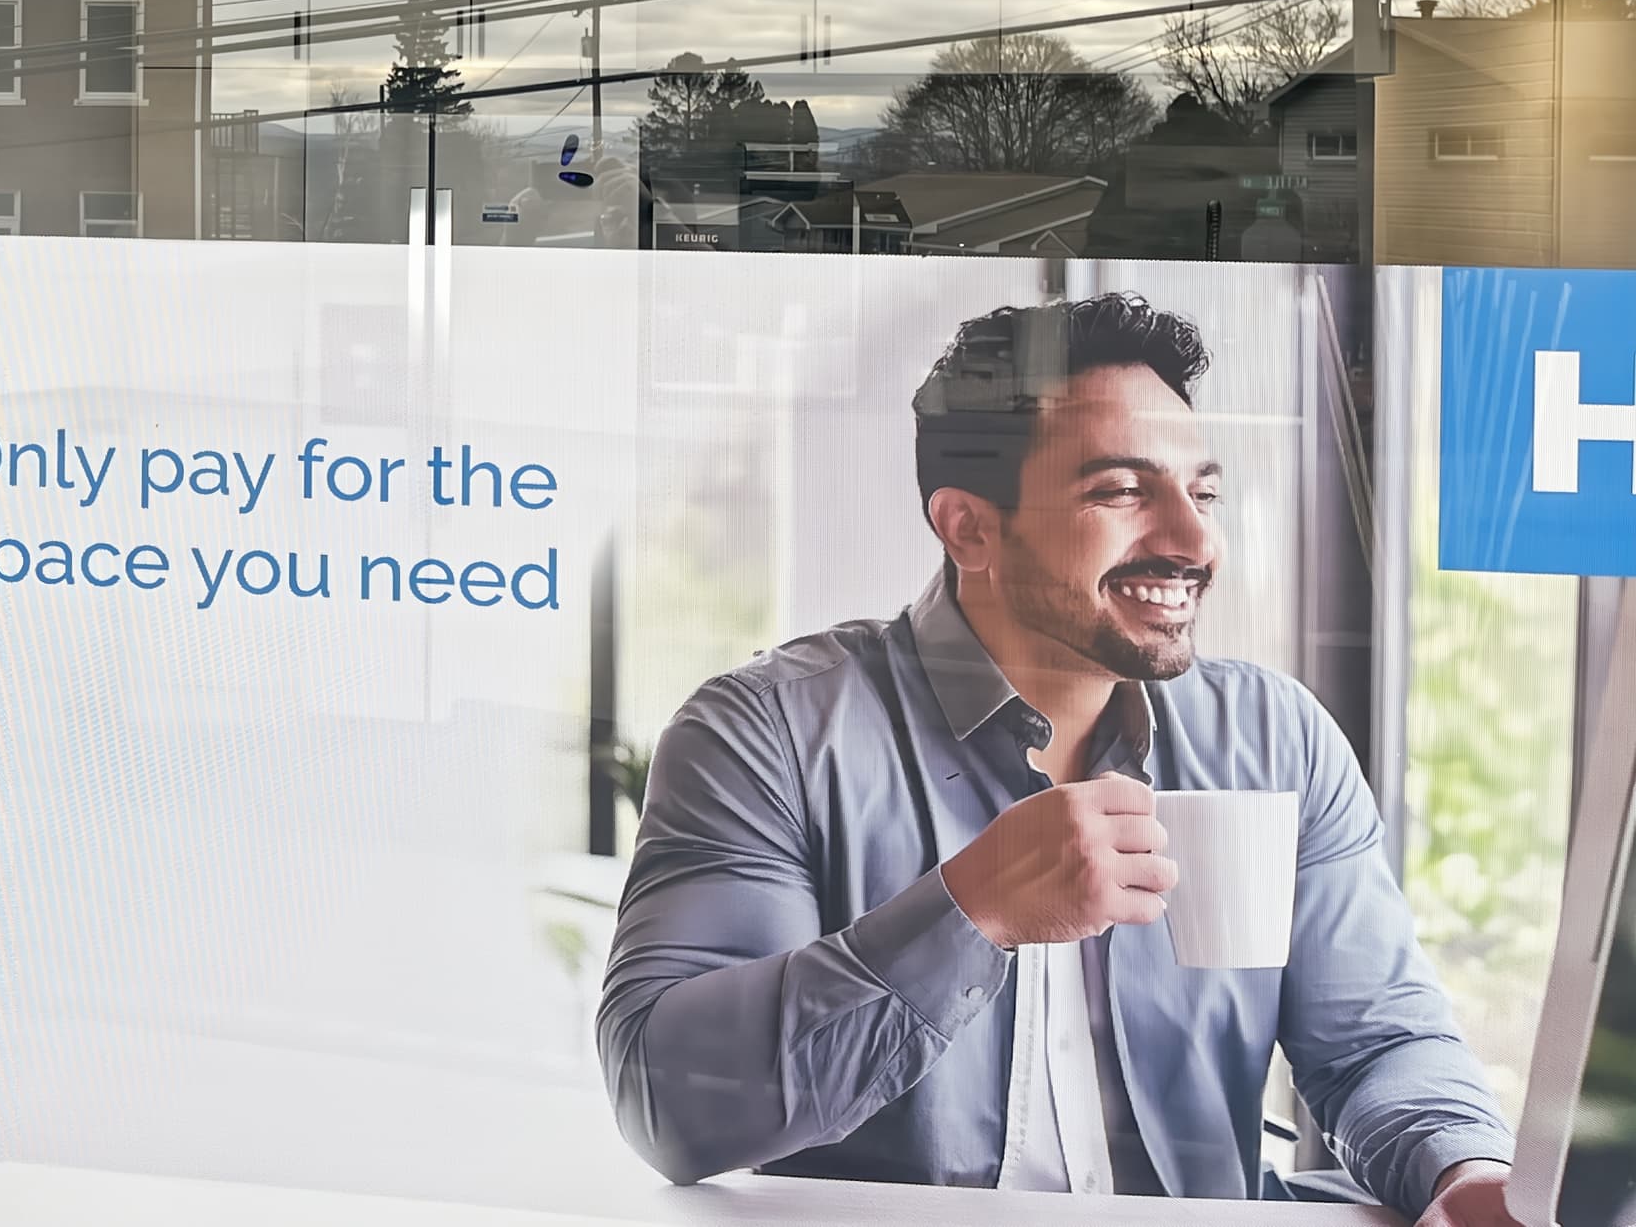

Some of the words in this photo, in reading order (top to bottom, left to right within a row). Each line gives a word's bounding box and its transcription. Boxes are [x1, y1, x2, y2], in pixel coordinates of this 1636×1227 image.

[675, 233, 719, 244] KEURIG
[140, 448, 276, 515] pay
[298, 437, 406, 503] for
[426, 444, 558, 511] the
[191, 547, 331, 610] you
[360, 547, 560, 611] need
